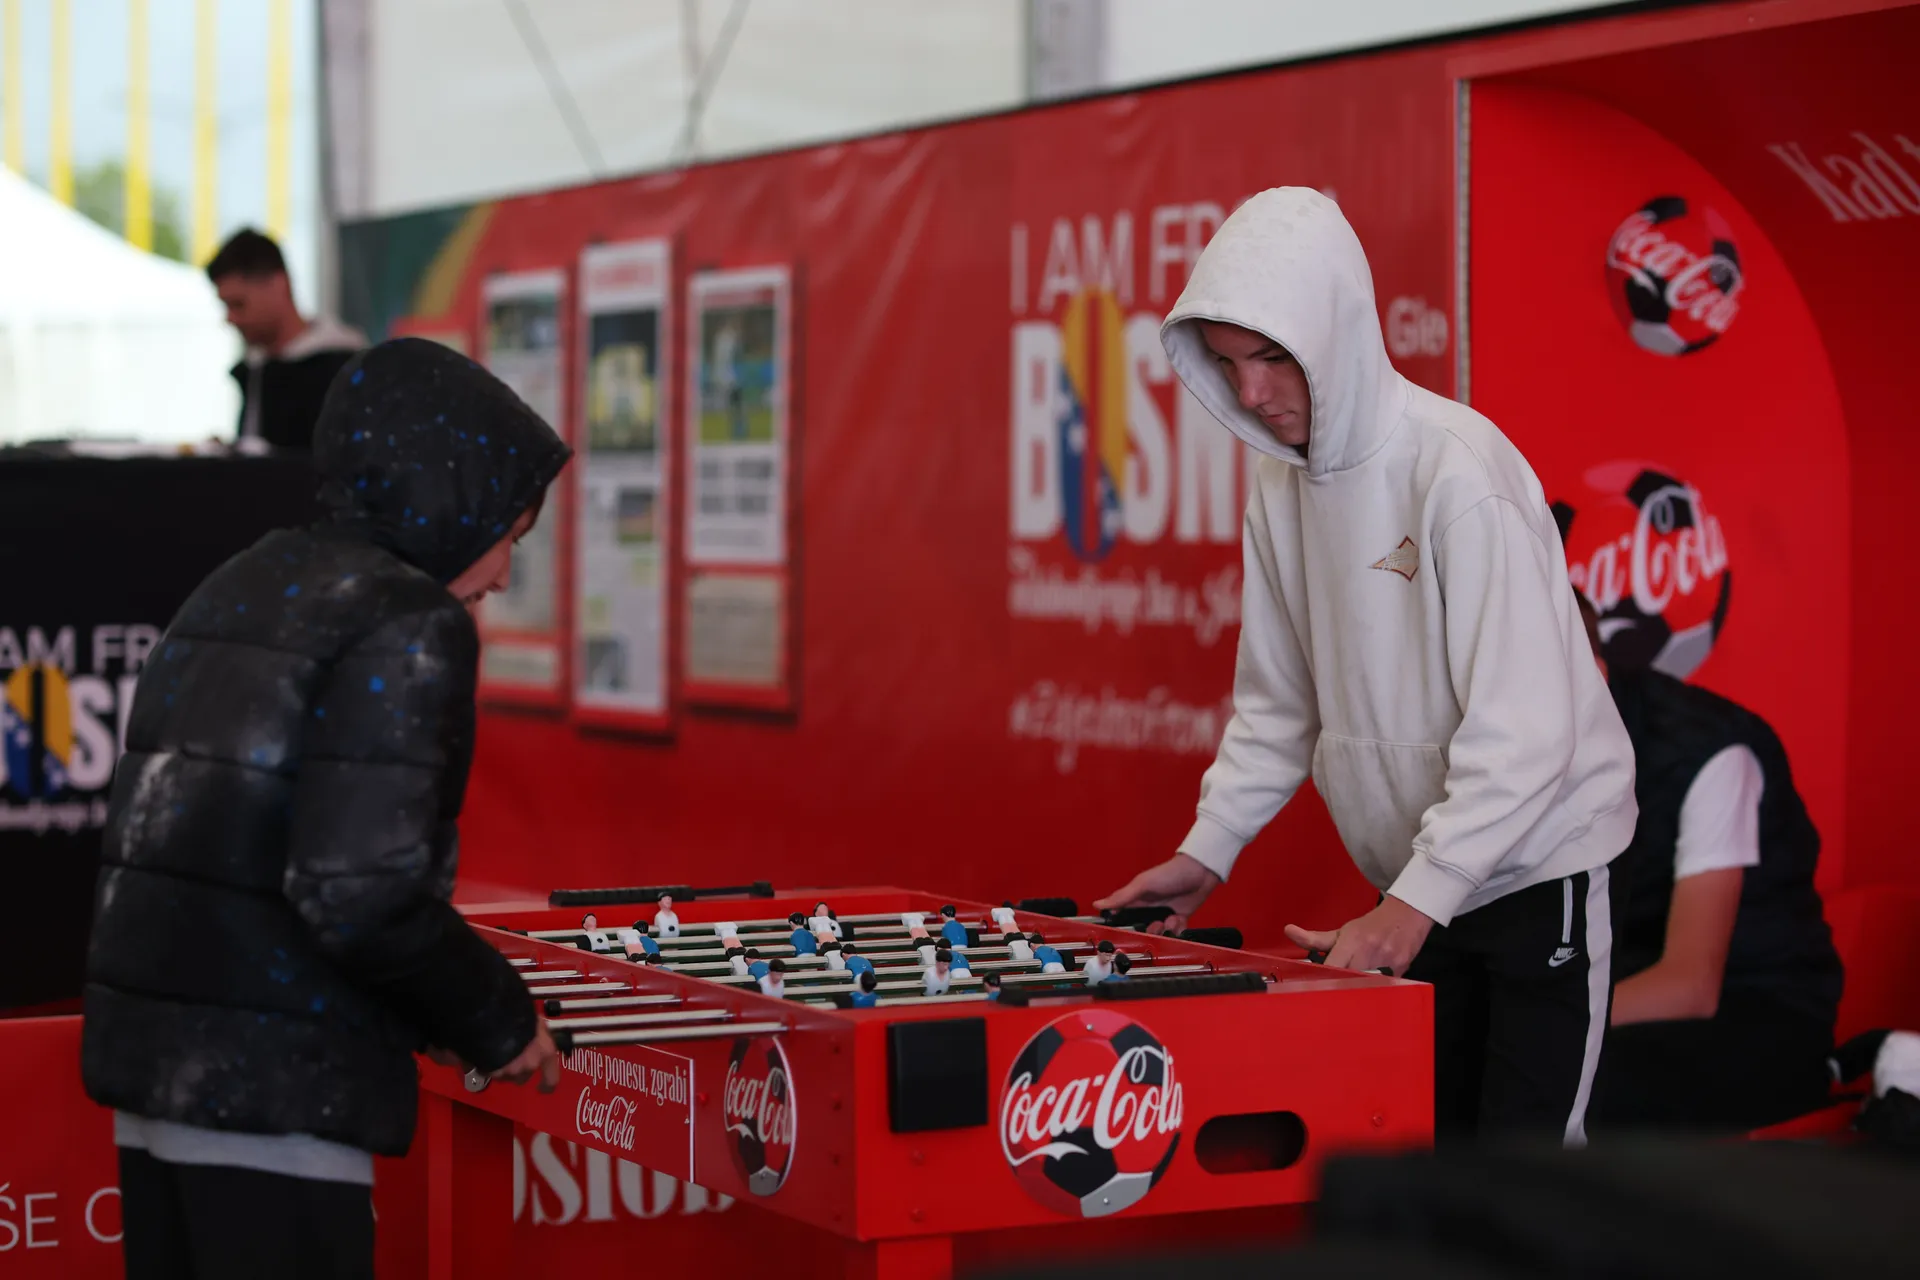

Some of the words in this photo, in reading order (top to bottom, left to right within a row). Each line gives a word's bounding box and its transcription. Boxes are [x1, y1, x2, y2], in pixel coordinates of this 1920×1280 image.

[1037, 212, 1133, 311] AM
[1150, 201, 1226, 304] FR
[1011, 284, 1242, 564] BOSN
[92, 624, 161, 672] FR
[576, 1085, 638, 1151] Coca-Cola
[605, 1054, 648, 1097] ponesu,
[650, 1065, 687, 1106] zgrabi
[1001, 1045, 1183, 1167] Coca-Cola
